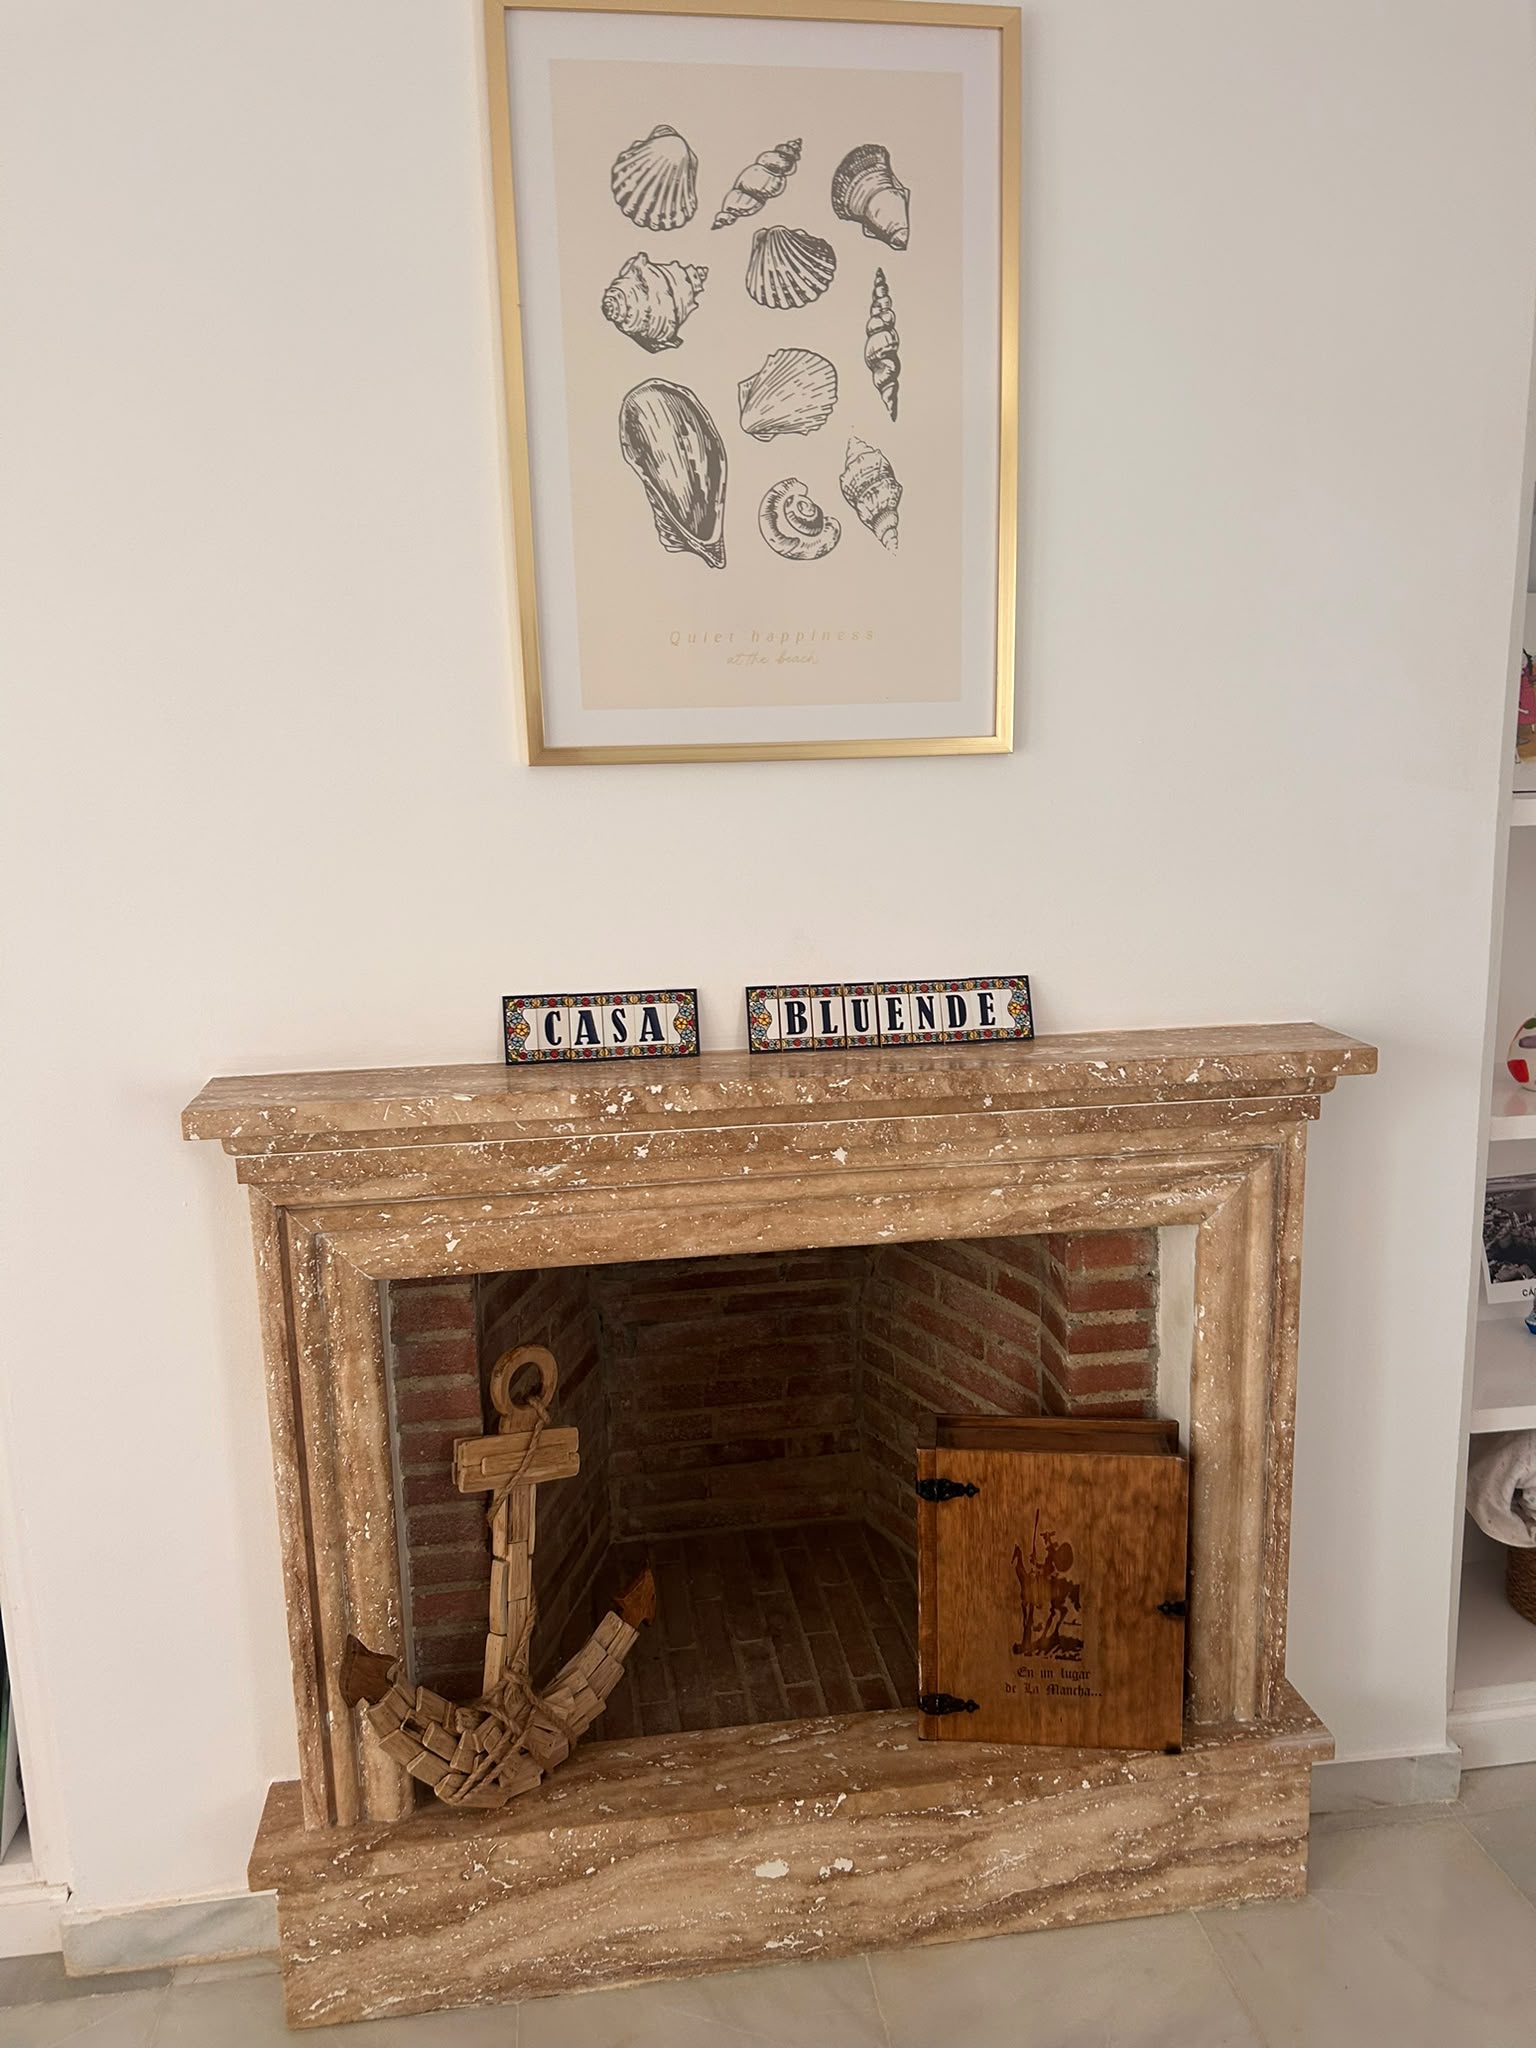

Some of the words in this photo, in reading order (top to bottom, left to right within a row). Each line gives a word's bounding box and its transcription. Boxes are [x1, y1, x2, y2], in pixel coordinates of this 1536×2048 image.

[669, 630, 734, 647] Quiet
[751, 629, 874, 644] happiness
[543, 1005, 666, 1047] CASA
[786, 992, 997, 1036] BLUENDE
[1017, 1666, 1034, 1678] En
[1040, 1669, 1053, 1679] un
[1061, 1668, 1091, 1681] lugar
[1005, 1682, 1016, 1694] de
[1024, 1682, 1039, 1695] La
